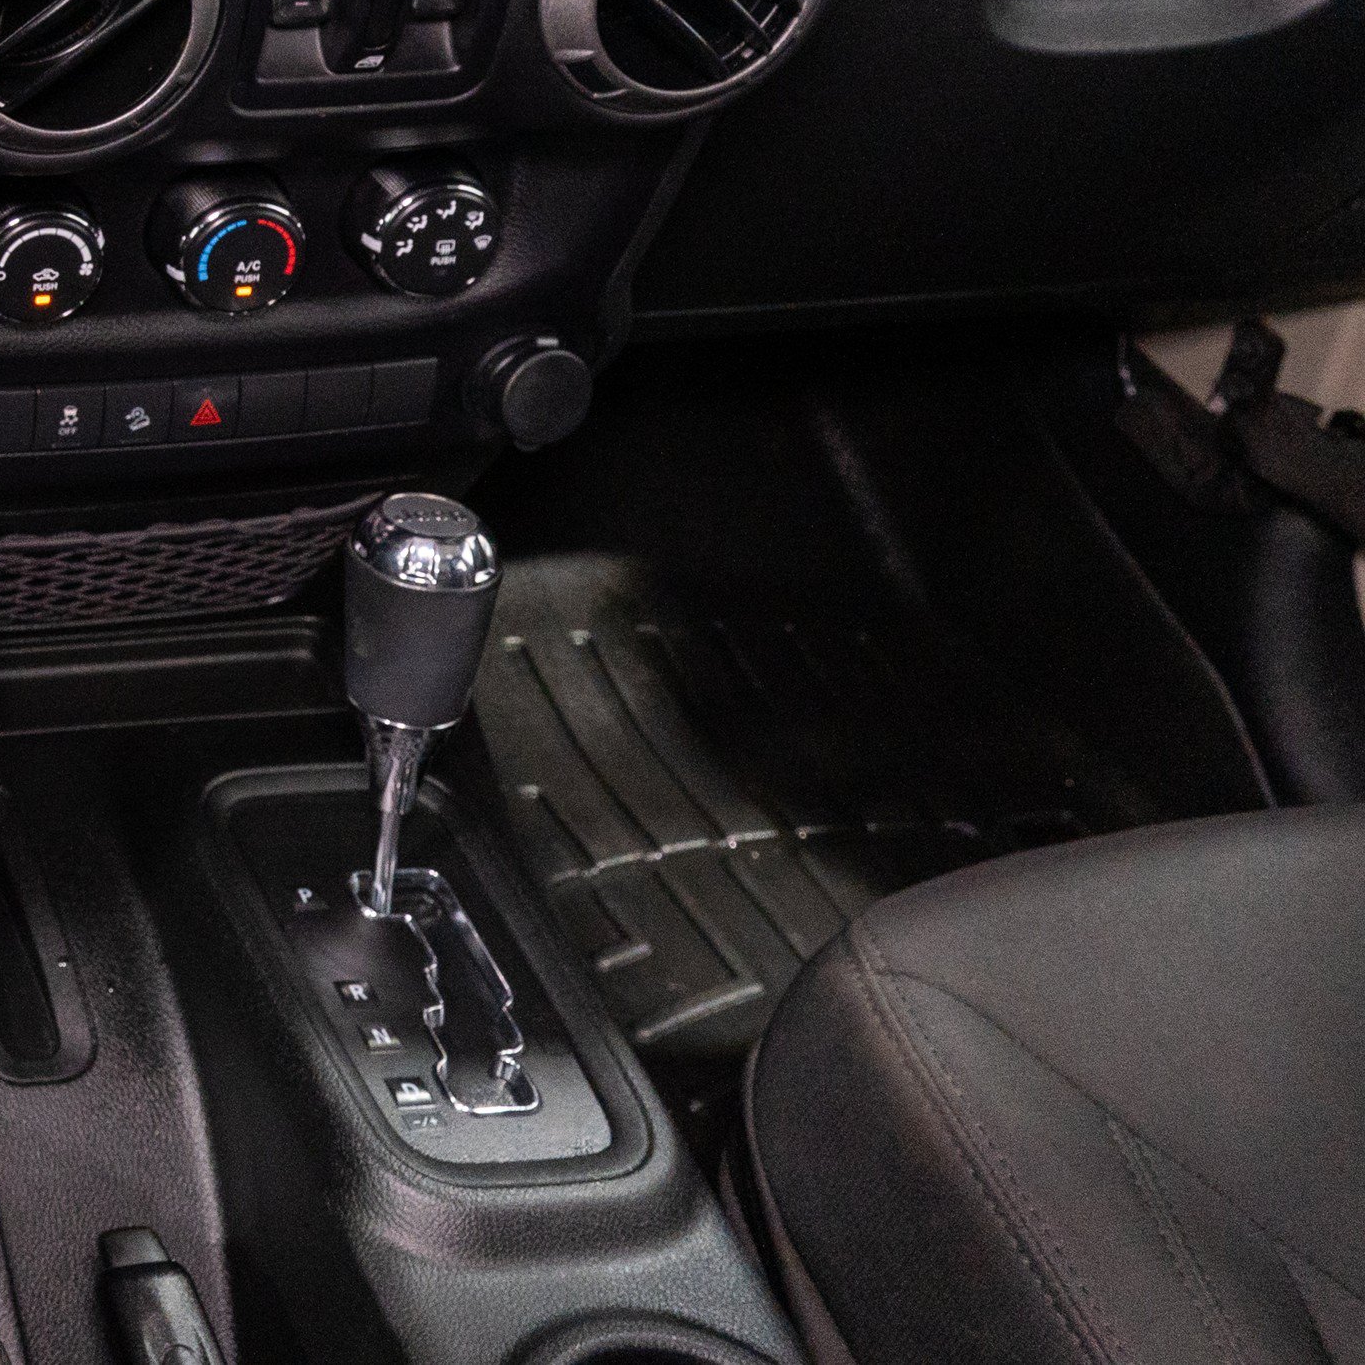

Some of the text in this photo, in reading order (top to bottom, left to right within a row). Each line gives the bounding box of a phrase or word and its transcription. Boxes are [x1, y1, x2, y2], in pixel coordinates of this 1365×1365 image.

[236, 260, 261, 273] A/C
[430, 255, 456, 267] PUSH
[234, 273, 260, 284] PUSH
[32, 282, 59, 292] PUSH
[297, 887, 313, 904] P
[349, 983, 368, 1001] R
[370, 1027, 391, 1044] N
